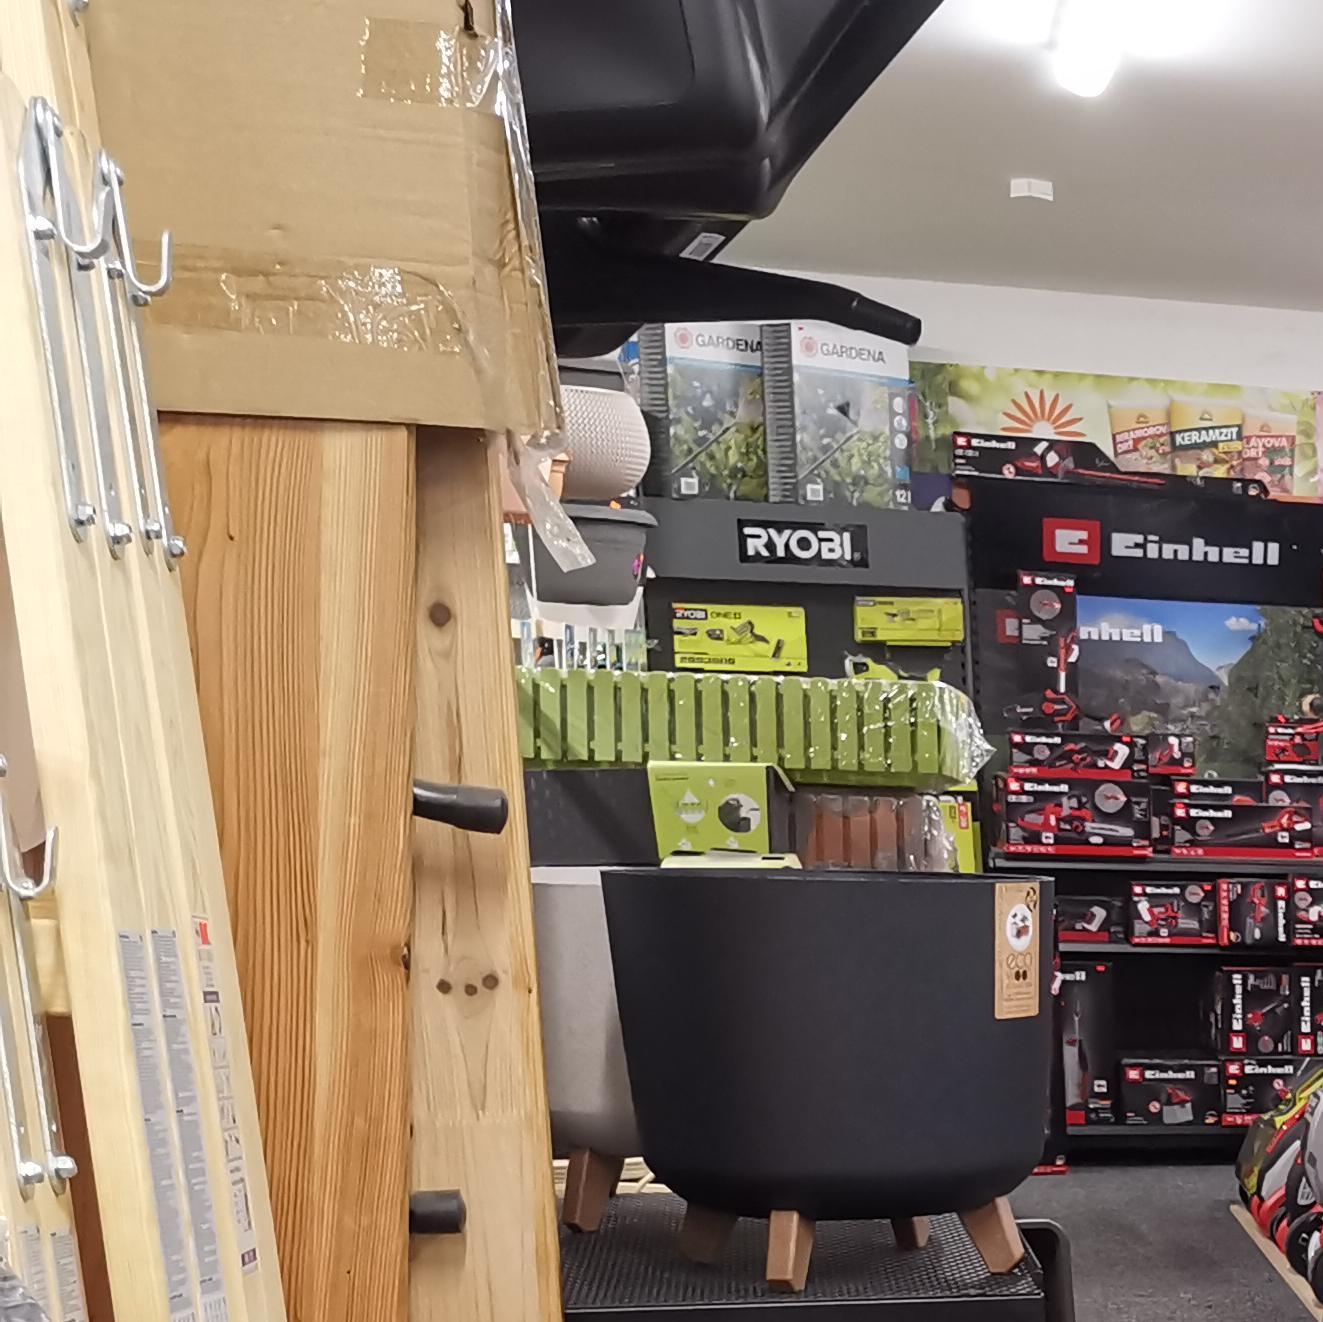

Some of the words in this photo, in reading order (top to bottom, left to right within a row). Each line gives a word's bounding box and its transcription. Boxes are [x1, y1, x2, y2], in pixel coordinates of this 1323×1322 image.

[695, 334, 763, 352] GARDENA
[819, 343, 886, 364] GARDENA
[1175, 426, 1239, 447] KERAMZIT
[742, 526, 852, 561] RYOBI
[1111, 532, 1280, 566] Einhell
[675, 608, 707, 620] RYOBI
[1079, 622, 1164, 643] nhell
[1231, 973, 1243, 1031] Einhell
[1300, 976, 1311, 1033] Einhell
